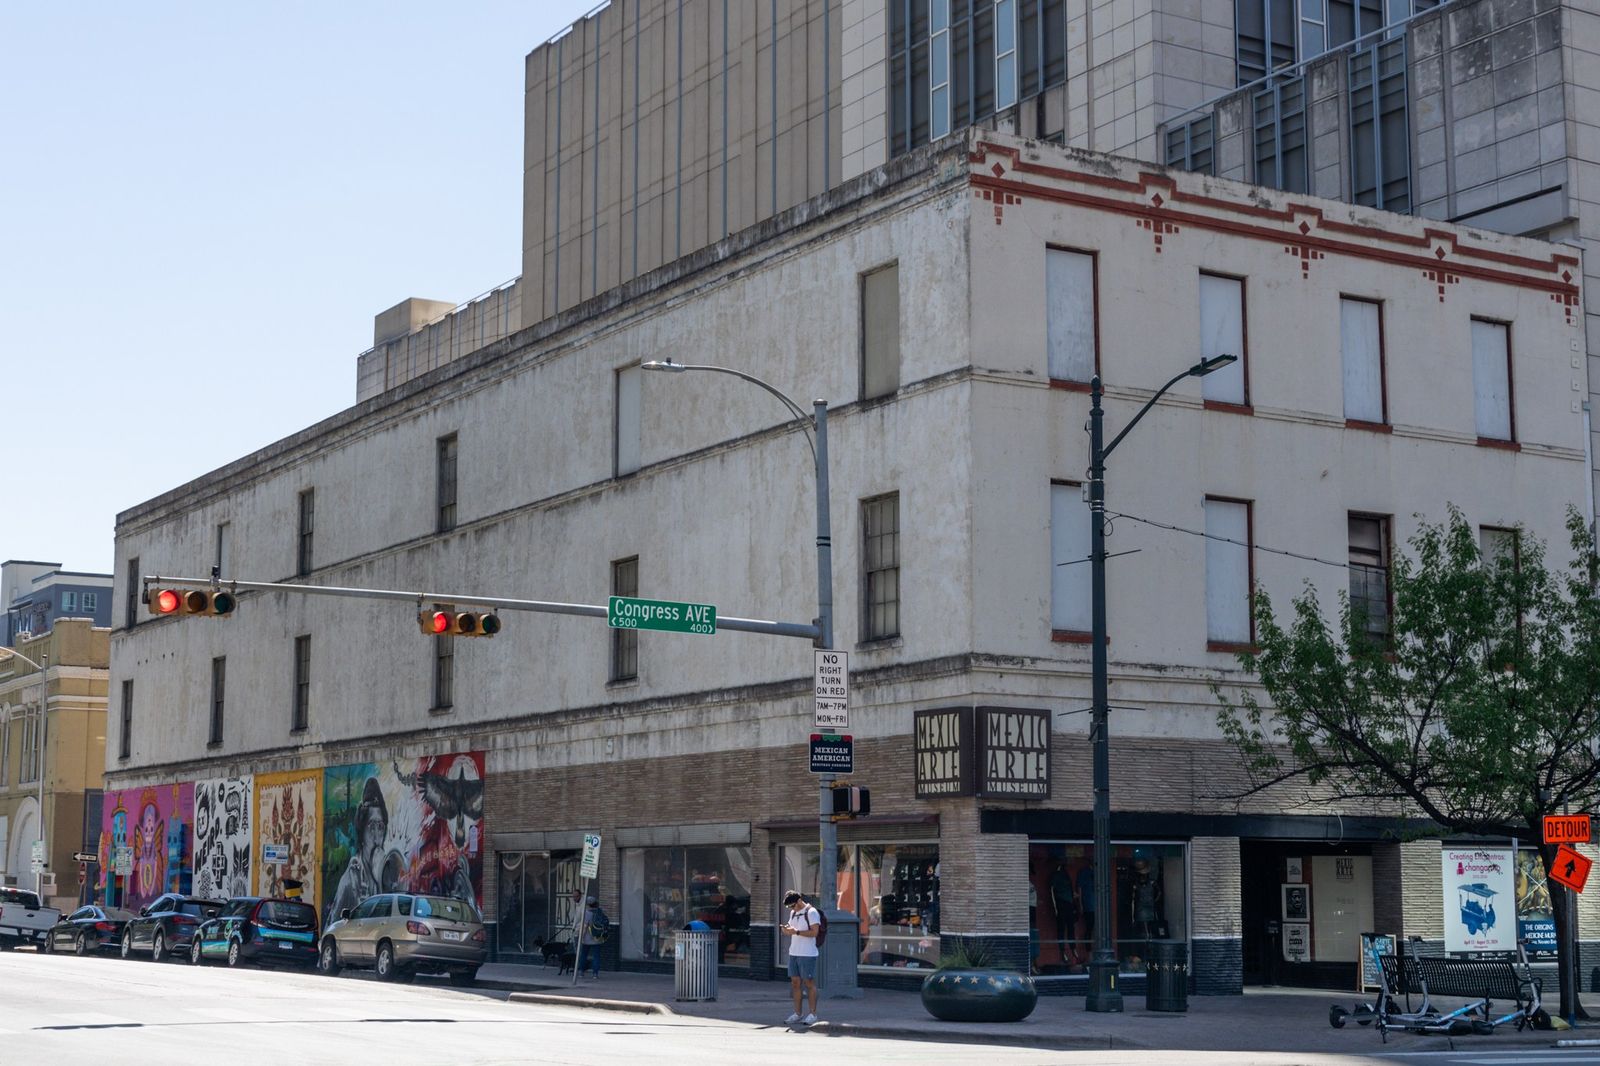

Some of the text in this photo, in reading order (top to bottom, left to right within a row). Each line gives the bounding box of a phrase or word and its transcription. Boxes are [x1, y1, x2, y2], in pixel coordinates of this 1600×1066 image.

[615, 599, 711, 623] Congress AVE
[619, 617, 637, 628] 500
[690, 623, 708, 633] 400
[823, 654, 838, 664] NO
[819, 666, 841, 675] RIGHT
[820, 676, 841, 685] TURN
[816, 686, 846, 695] ON RED
[918, 712, 960, 749] MEXIC
[988, 712, 1046, 749] MEXIC
[814, 746, 849, 754] MEXICAN
[812, 754, 851, 762] AMERICAN
[919, 749, 960, 780] ARTE
[988, 749, 1046, 780] ARTE
[917, 782, 960, 794] MUSEUM
[988, 782, 1046, 794] MUSEUM
[1547, 820, 1588, 838] DETOUR
[1449, 852, 1473, 863] Creating
[1534, 923, 1554, 931] ORIGINS
